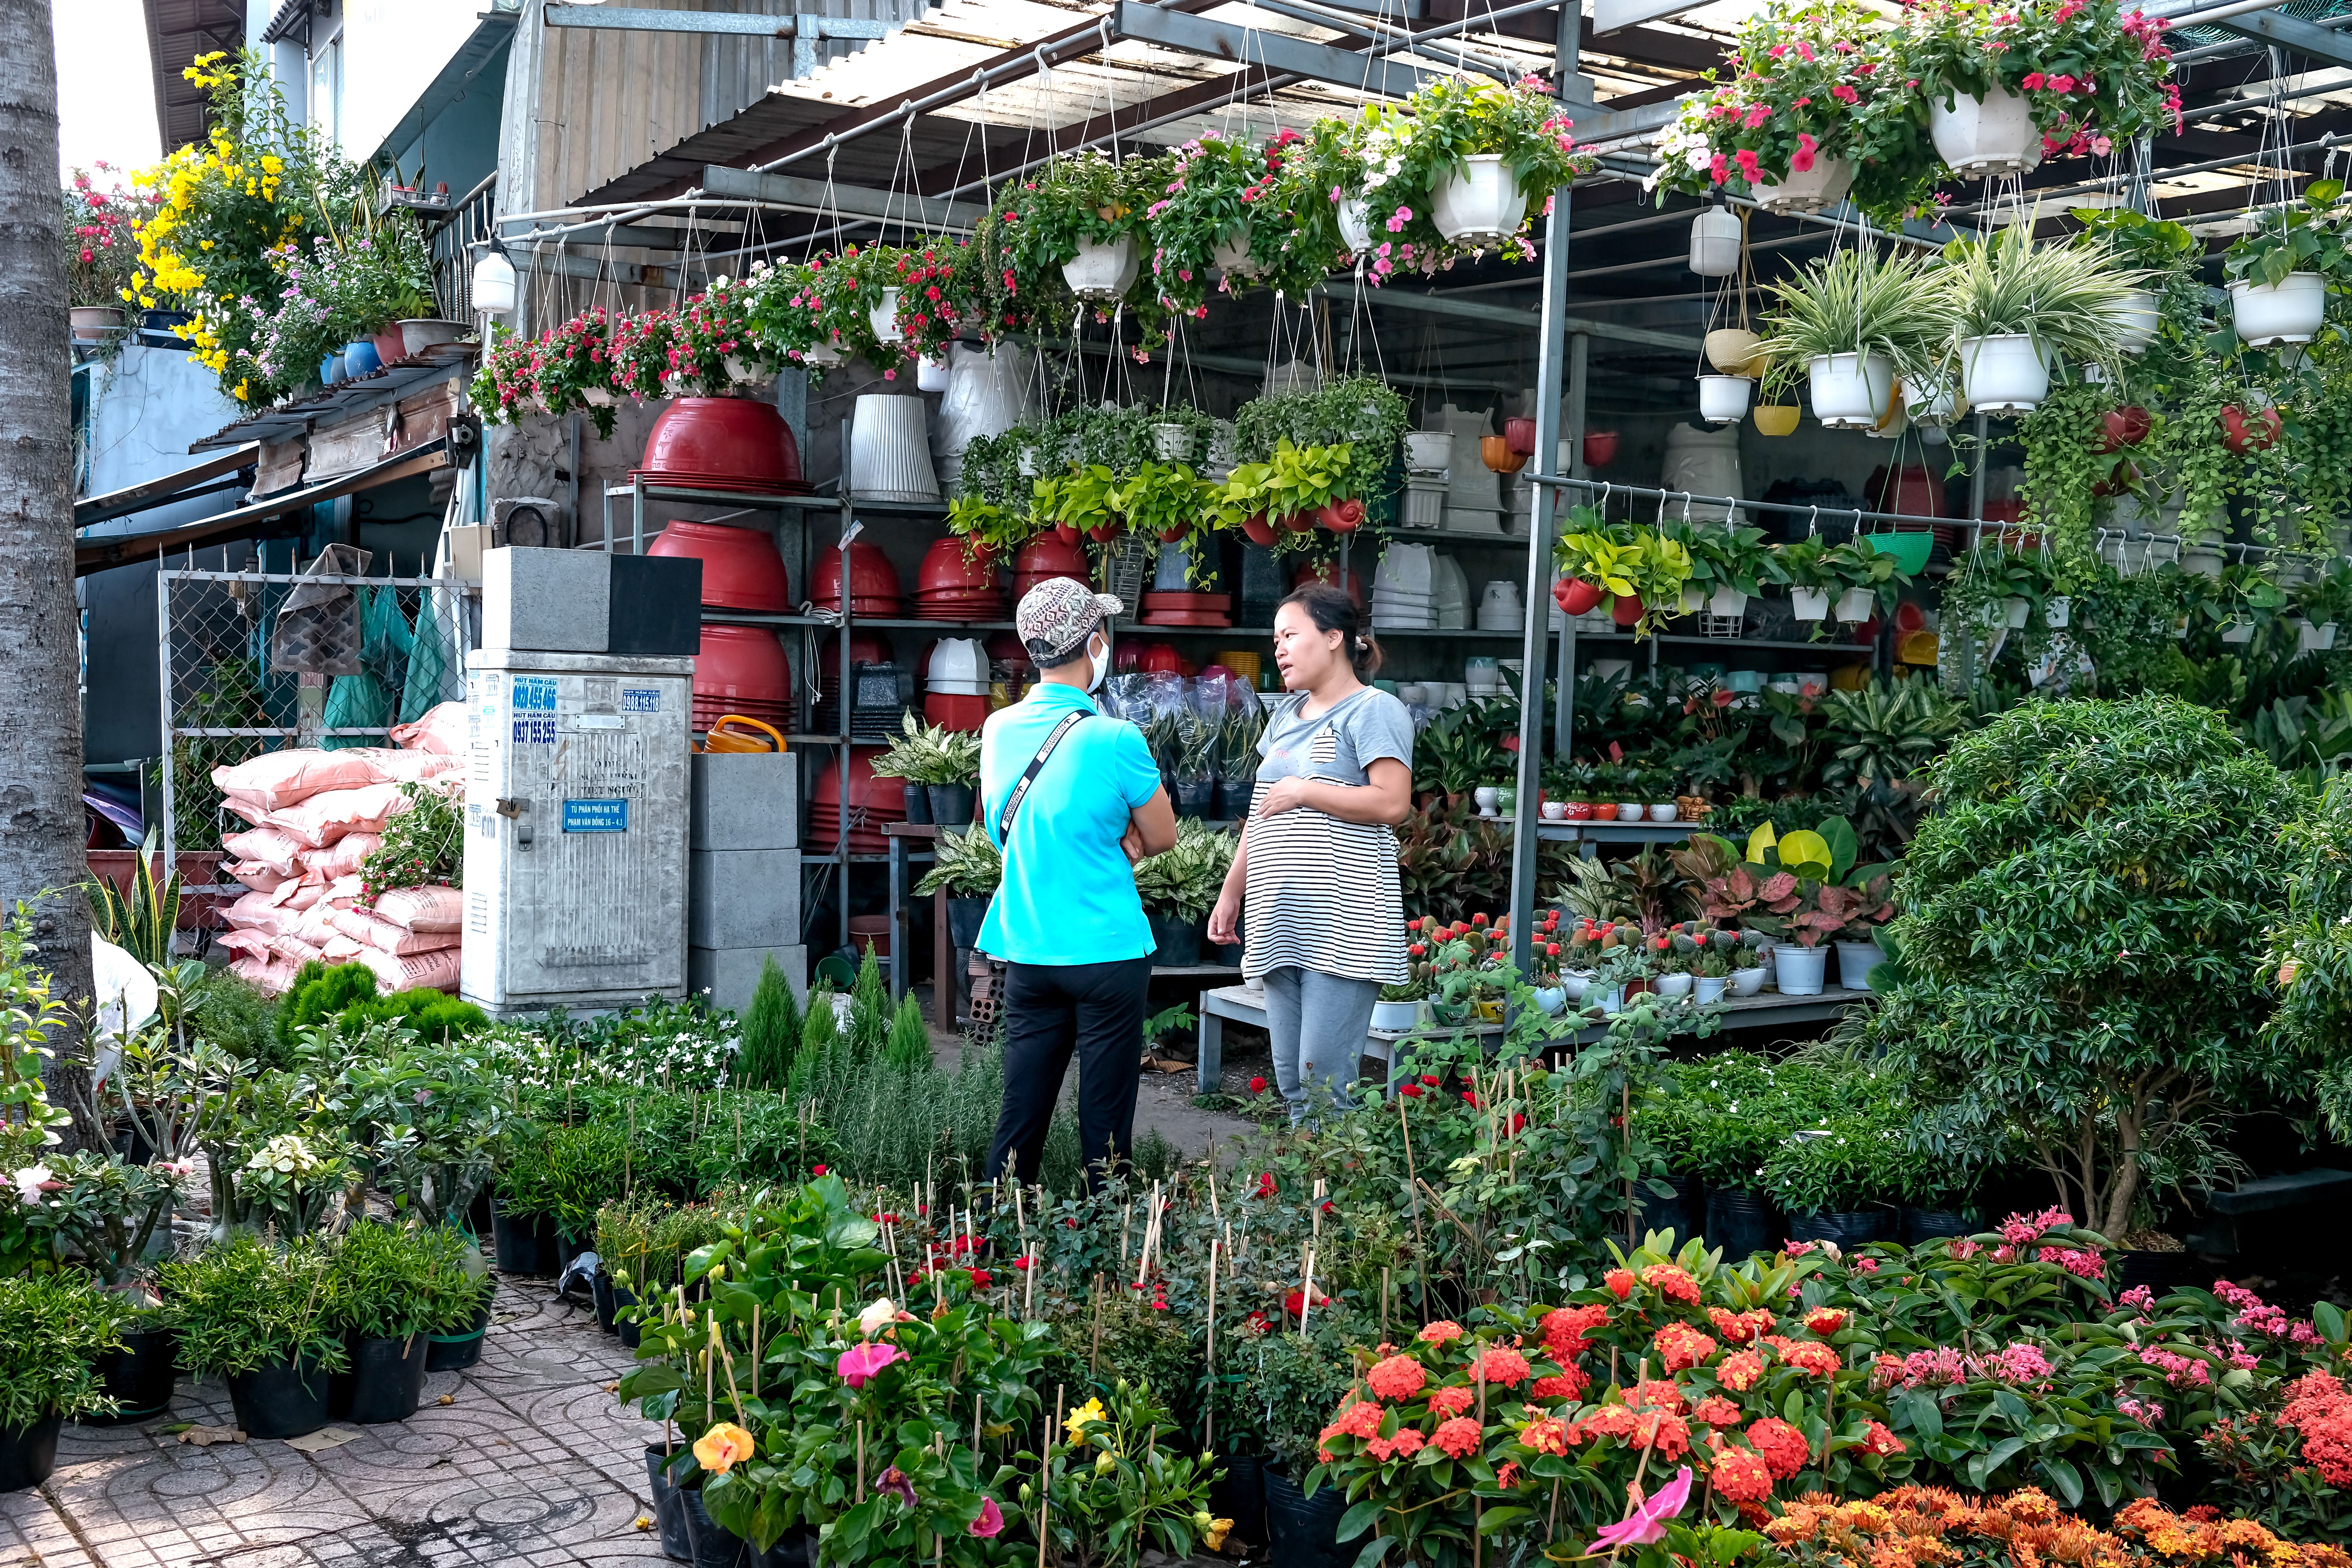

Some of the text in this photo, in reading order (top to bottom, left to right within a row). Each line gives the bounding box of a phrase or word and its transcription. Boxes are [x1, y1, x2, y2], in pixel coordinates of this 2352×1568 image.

[513, 685, 556, 711] 0928.455.466
[623, 695, 659, 712] 0988.115.118
[513, 721, 555, 744] 0937.155.255
[1042, 724, 1064, 753] NUTRITION
[1045, 726, 1066, 755] HERBALIFE
[1003, 792, 1018, 822] NUTRITION
[1006, 794, 1021, 824] HERBALIFE
